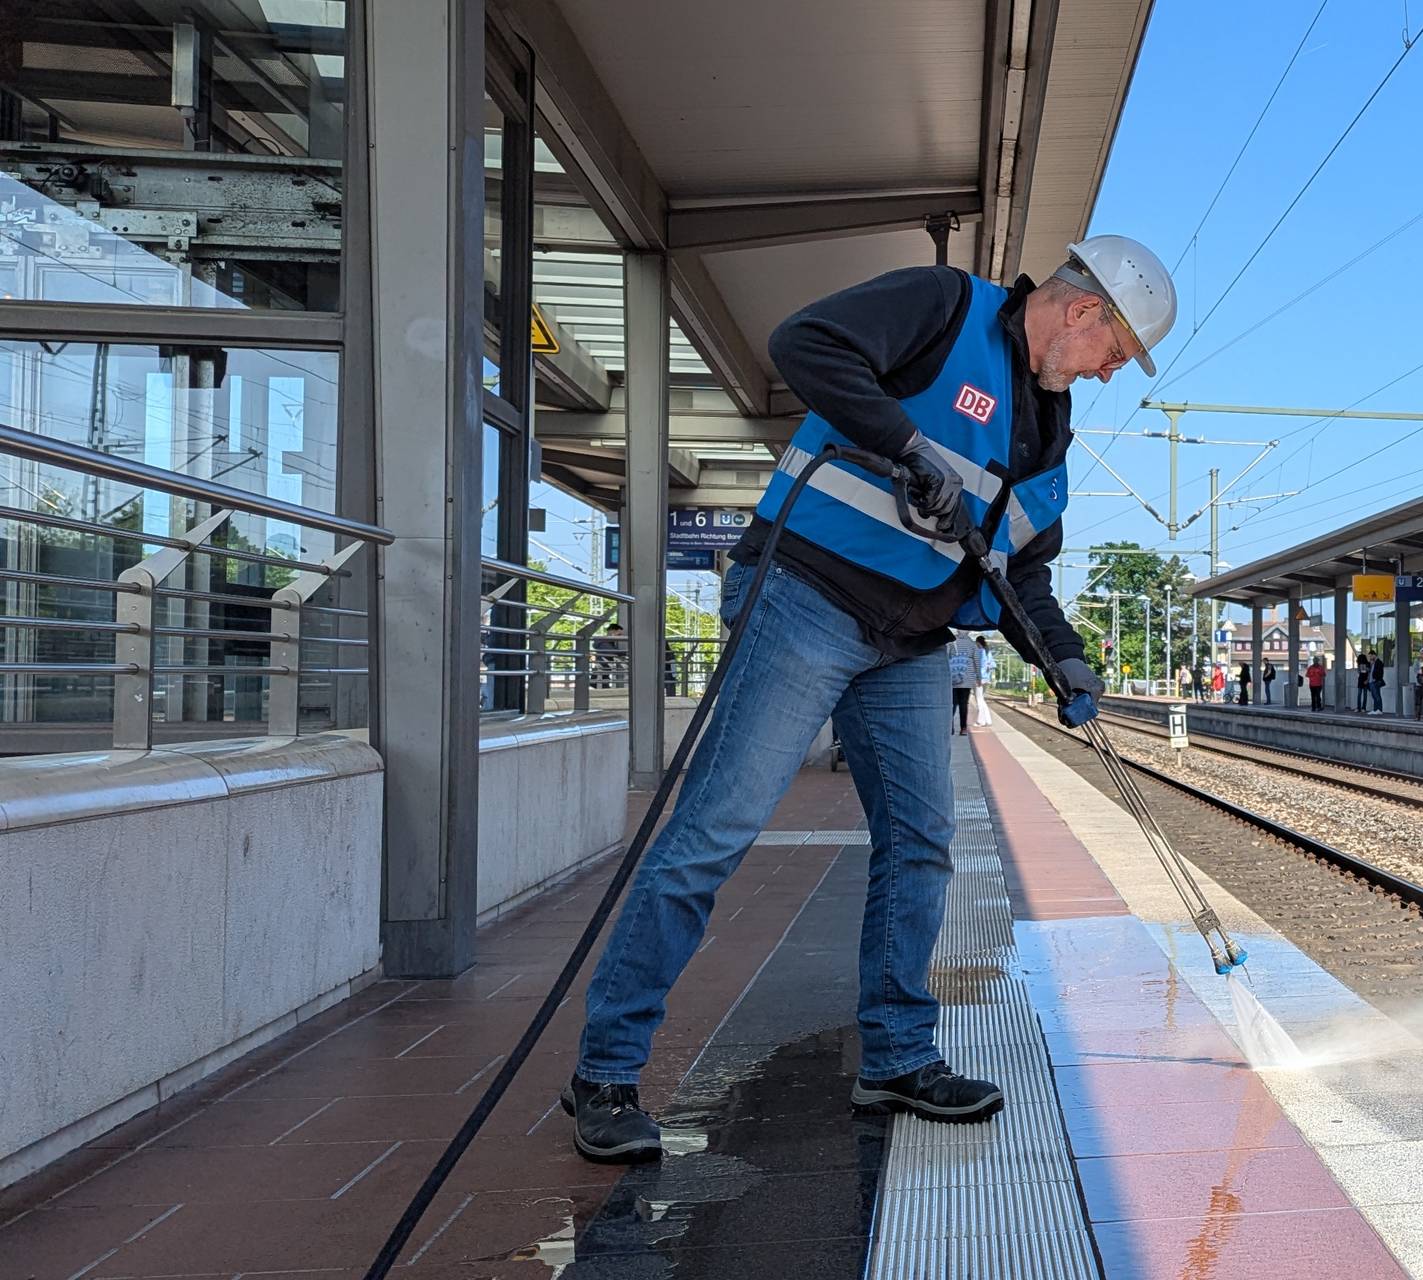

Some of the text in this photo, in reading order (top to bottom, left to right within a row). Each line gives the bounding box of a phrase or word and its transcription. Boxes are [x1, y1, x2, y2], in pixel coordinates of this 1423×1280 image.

[959, 387, 991, 419] DB
[669, 511, 678, 526] 1
[695, 511, 707, 527] 6
[701, 532, 726, 541] Richtung
[1215, 630, 1221, 642] 1
[1172, 715, 1185, 736] H
